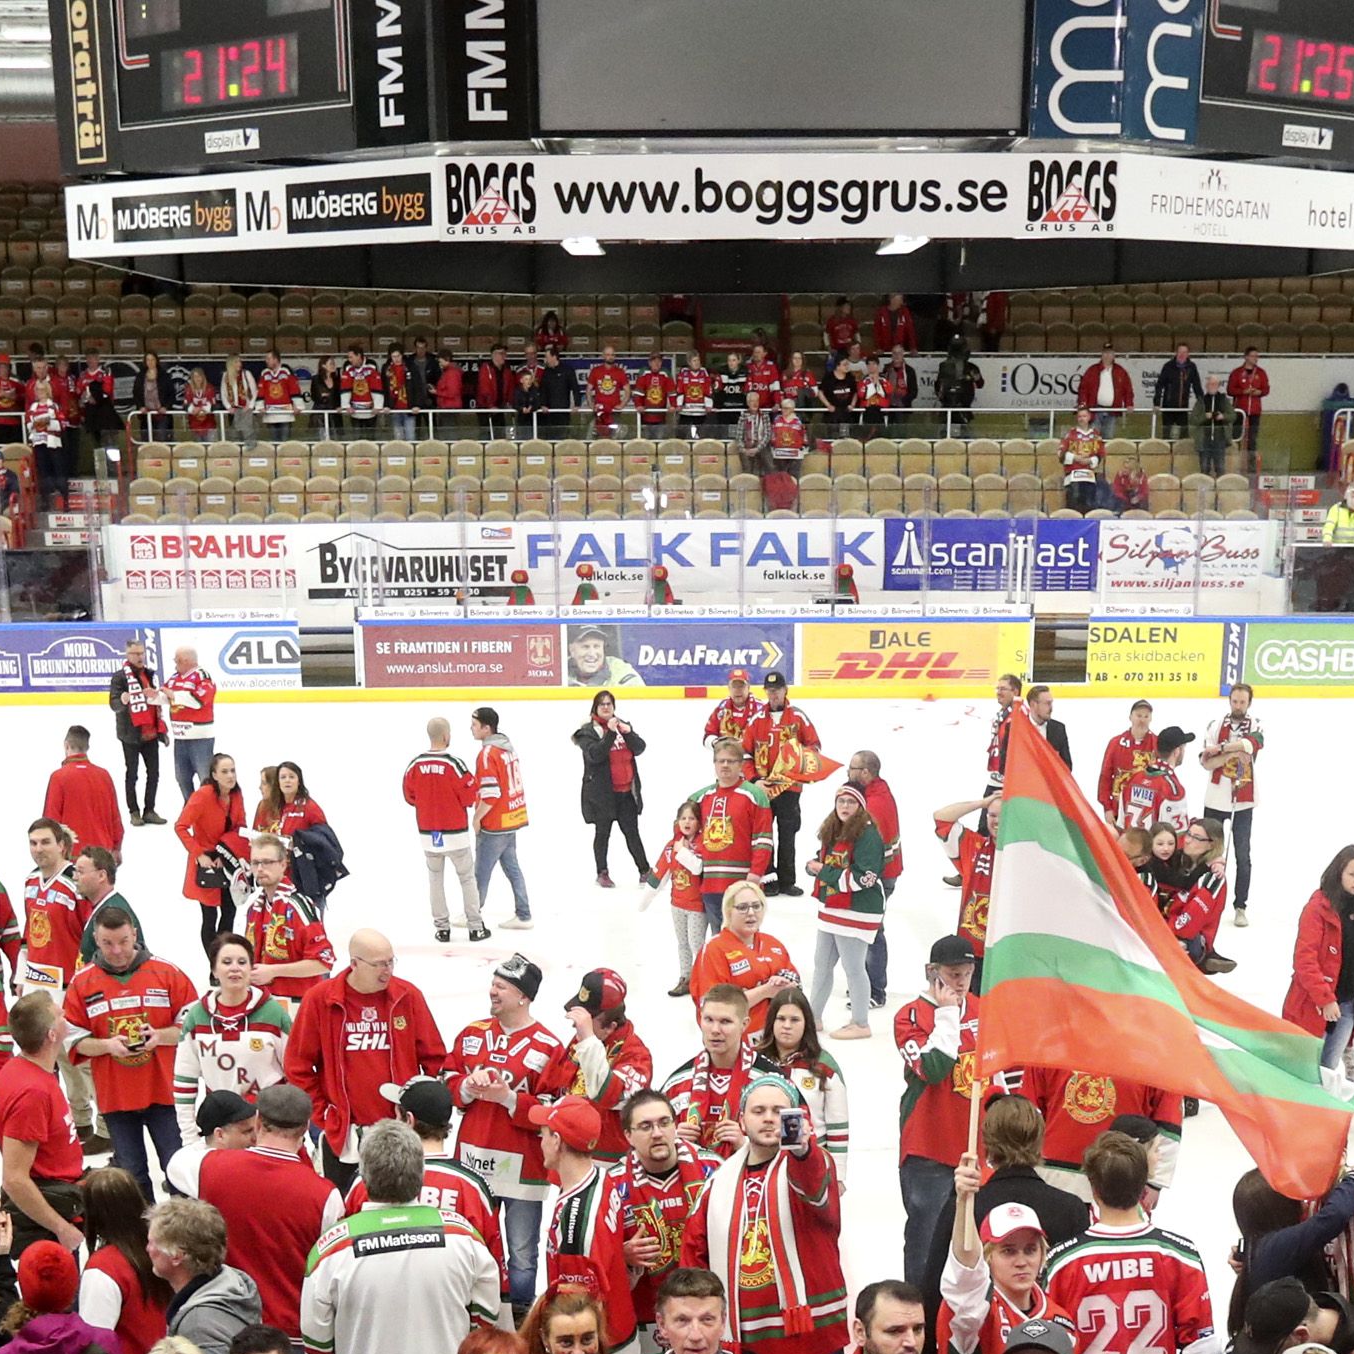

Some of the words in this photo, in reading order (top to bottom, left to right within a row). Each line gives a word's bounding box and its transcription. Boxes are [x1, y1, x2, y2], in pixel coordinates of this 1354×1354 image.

[183, 38, 287, 104] 21:24
[466, 41, 508, 121] FM
[377, 46, 406, 128] FM
[292, 190, 378, 220] MJÖBERG
[382, 185, 425, 221] bygg
[446, 162, 536, 224] BOGGS
[553, 167, 1008, 224] www.boggsgrus.se
[1028, 159, 1118, 222] BOGGS
[118, 203, 191, 231] MJÖBERG
[195, 199, 233, 232] bygg
[1150, 194, 1270, 221] FRIDHEMSGATAN
[447, 226, 498, 235] GRUS
[513, 226, 536, 234] AB
[1025, 222, 1077, 232] GRUS
[1091, 223, 1114, 232] AB
[1193, 221, 1229, 237] HOTELL
[160, 534, 287, 559] BRAHUS
[527, 532, 694, 568] FALK
[710, 530, 876, 567] FALK
[763, 569, 826, 581] falklack.se
[403, 588, 429, 597] 0251
[63, 642, 96, 658] MORA
[376, 642, 392, 655] SE
[394, 641, 461, 655] FRAMTIDEN
[464, 641, 469, 653] I
[471, 640, 512, 653] FIBERN
[1090, 648, 1122, 662] nära
[1126, 648, 1205, 662] skidbacken
[1224, 622, 1243, 686] CCM
[386, 662, 503, 675] www.anslut.mora.se
[527, 670, 554, 678] MORA
[833, 652, 967, 680] DHL
[1095, 672, 1108, 682] AB
[1123, 672, 1143, 682] 070
[1147, 672, 1165, 682] 211
[1168, 672, 1184, 682] 35
[1186, 672, 1198, 682] 18
[346, 1034, 391, 1051] SHL
[199, 1040, 261, 1097] MORA
[358, 1235, 380, 1251] FM
[381, 1230, 441, 1249] Mattsson
[1082, 1258, 1155, 1283] WIBE
